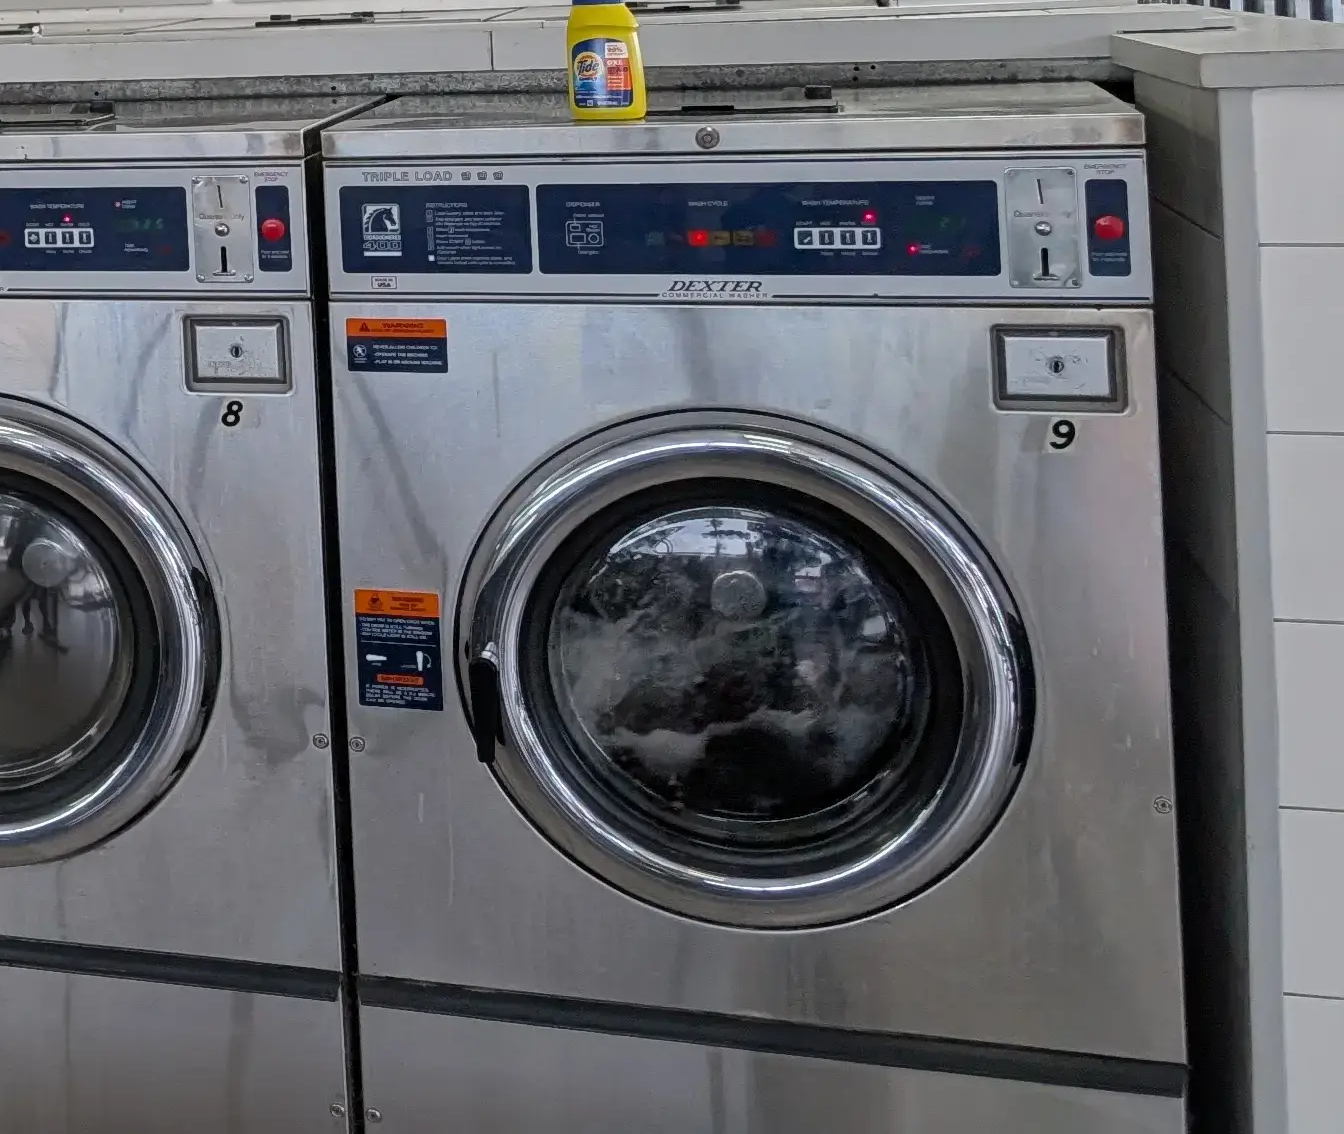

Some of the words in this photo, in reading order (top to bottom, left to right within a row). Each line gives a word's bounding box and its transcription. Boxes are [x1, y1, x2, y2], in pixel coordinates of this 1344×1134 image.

[577, 59, 600, 76] Tide
[362, 171, 409, 182] TRIPLE
[414, 171, 452, 182] LOAD
[363, 241, 401, 250] 400
[667, 280, 762, 292] DEXTER
[221, 400, 243, 427] 8
[1049, 419, 1076, 450] 9
